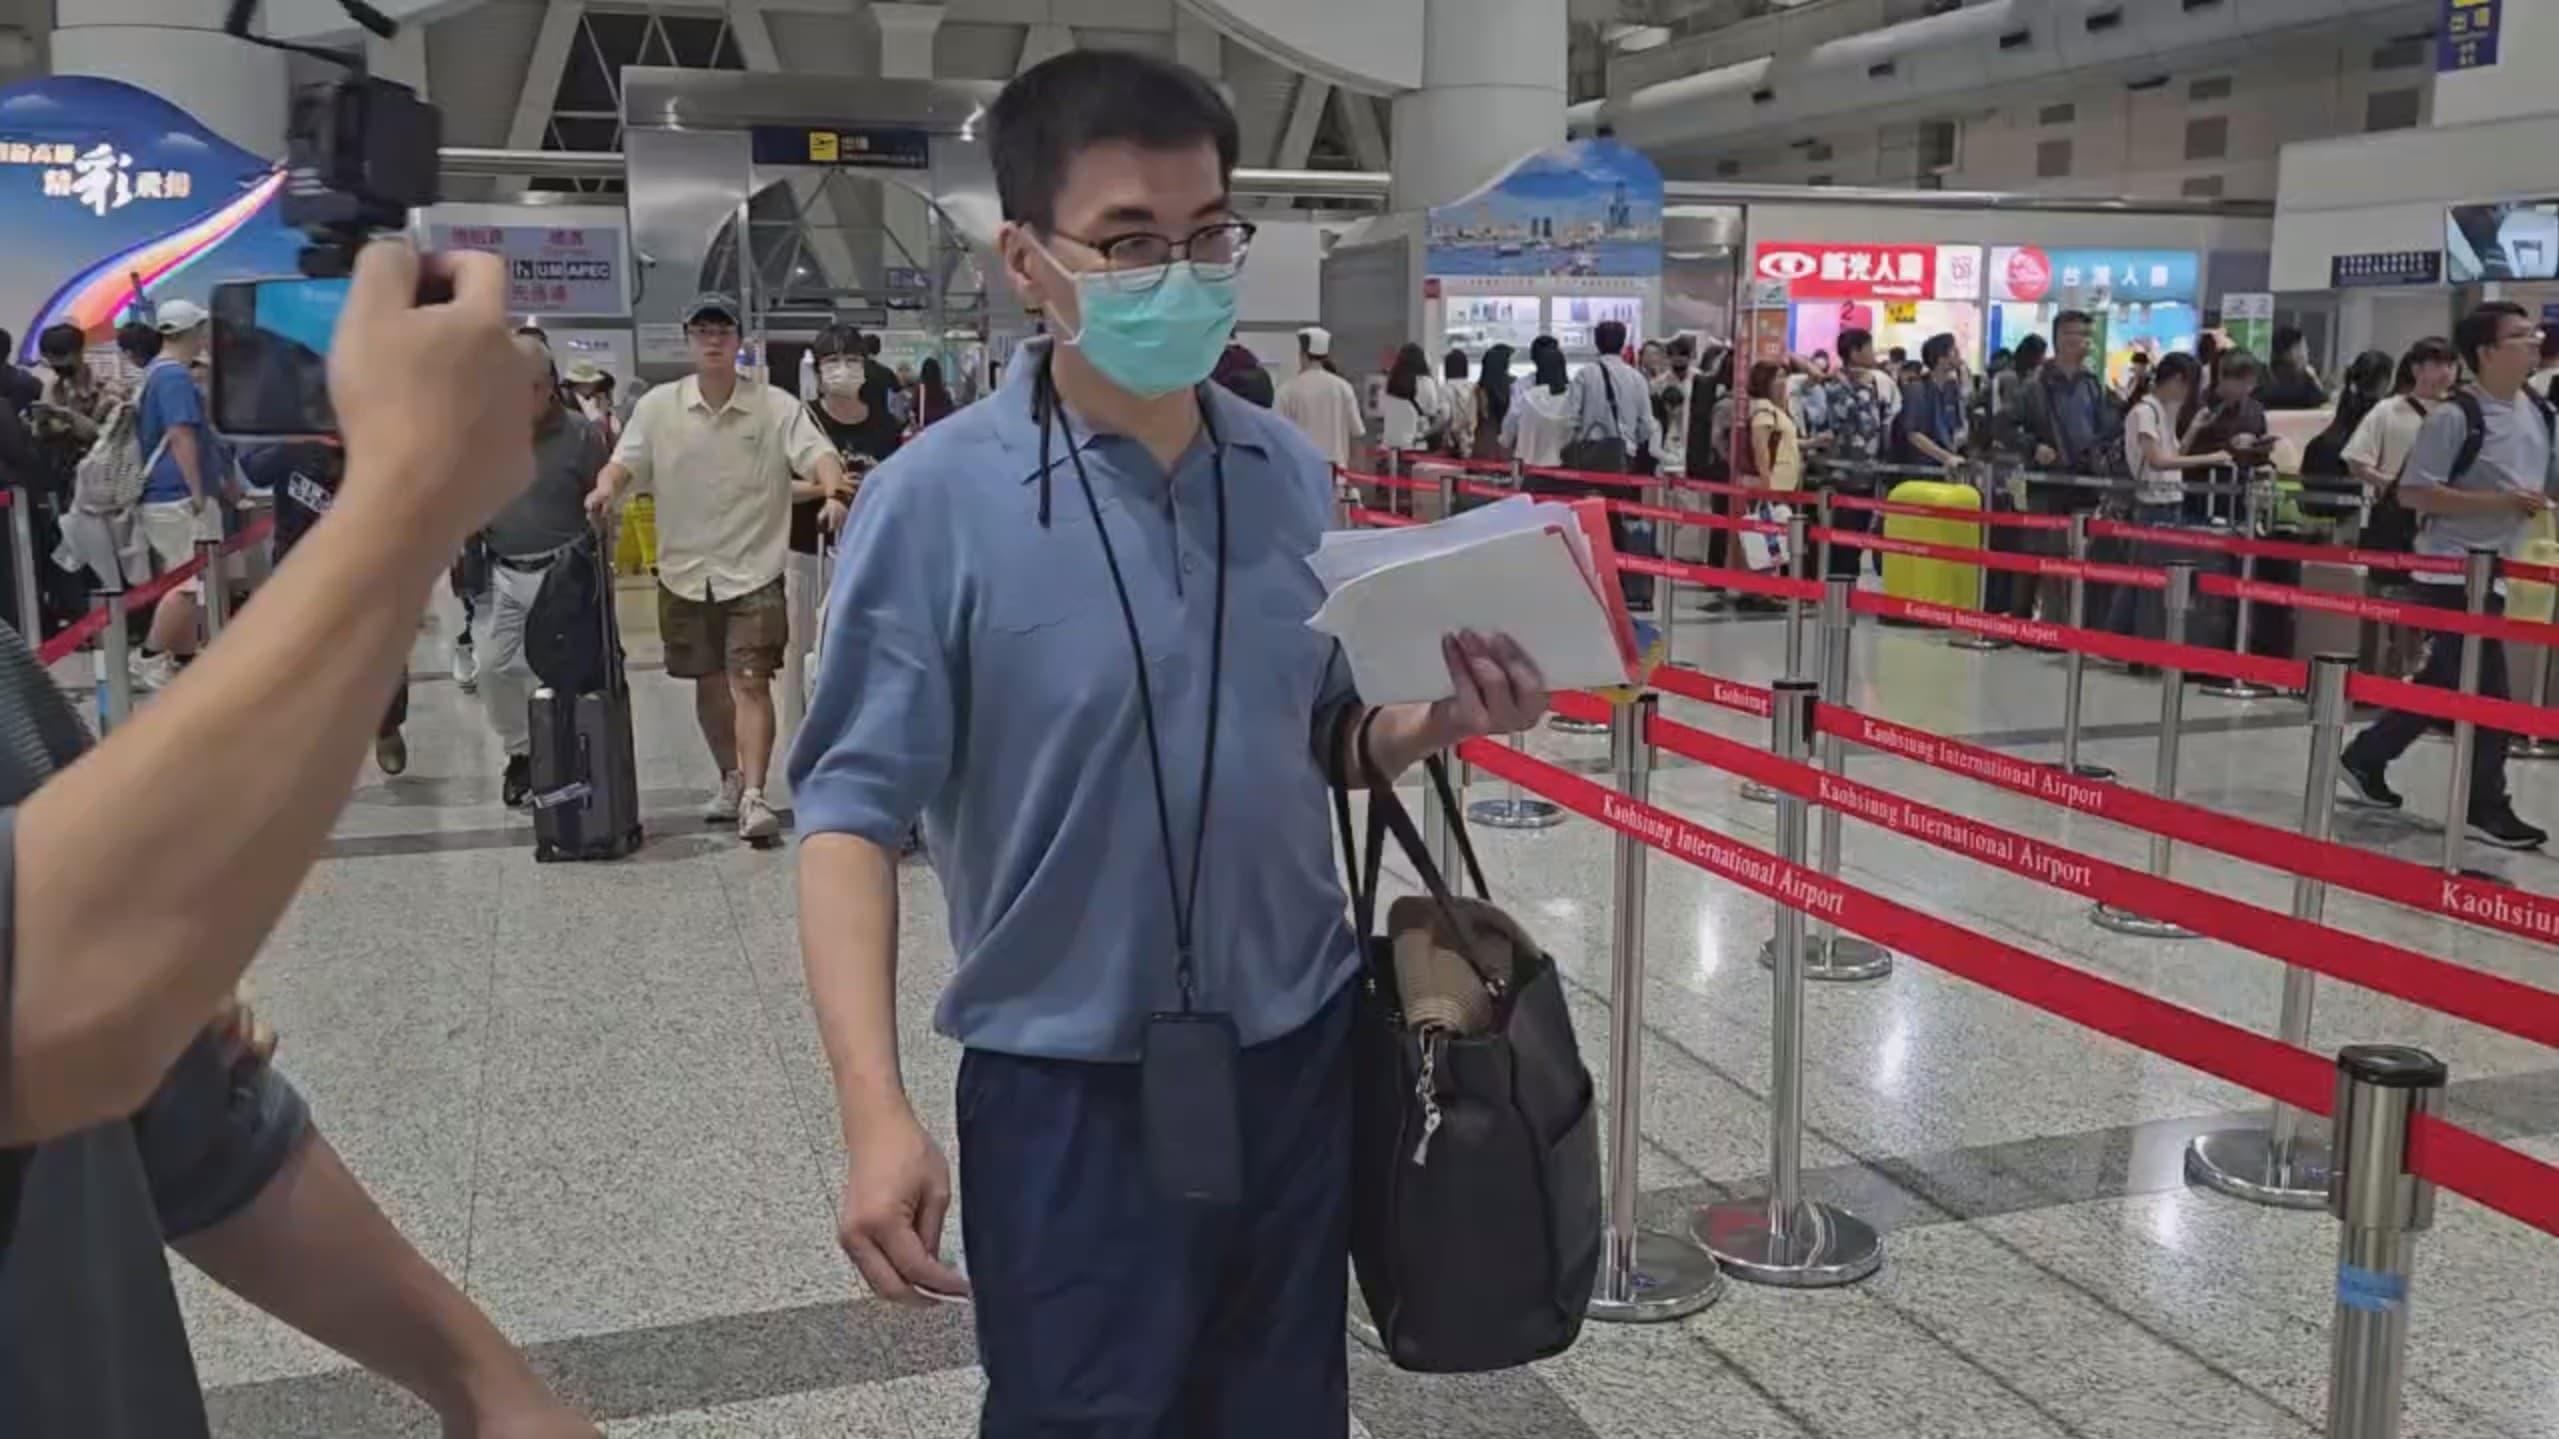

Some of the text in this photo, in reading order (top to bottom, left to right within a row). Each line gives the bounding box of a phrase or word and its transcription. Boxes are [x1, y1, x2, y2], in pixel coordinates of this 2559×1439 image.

[1863, 718, 2103, 807] Kaohsiung International Airport
[1603, 795, 1846, 915] Kaohsiung International Airport
[1819, 776, 2092, 887] Kaohsiung International Airport
